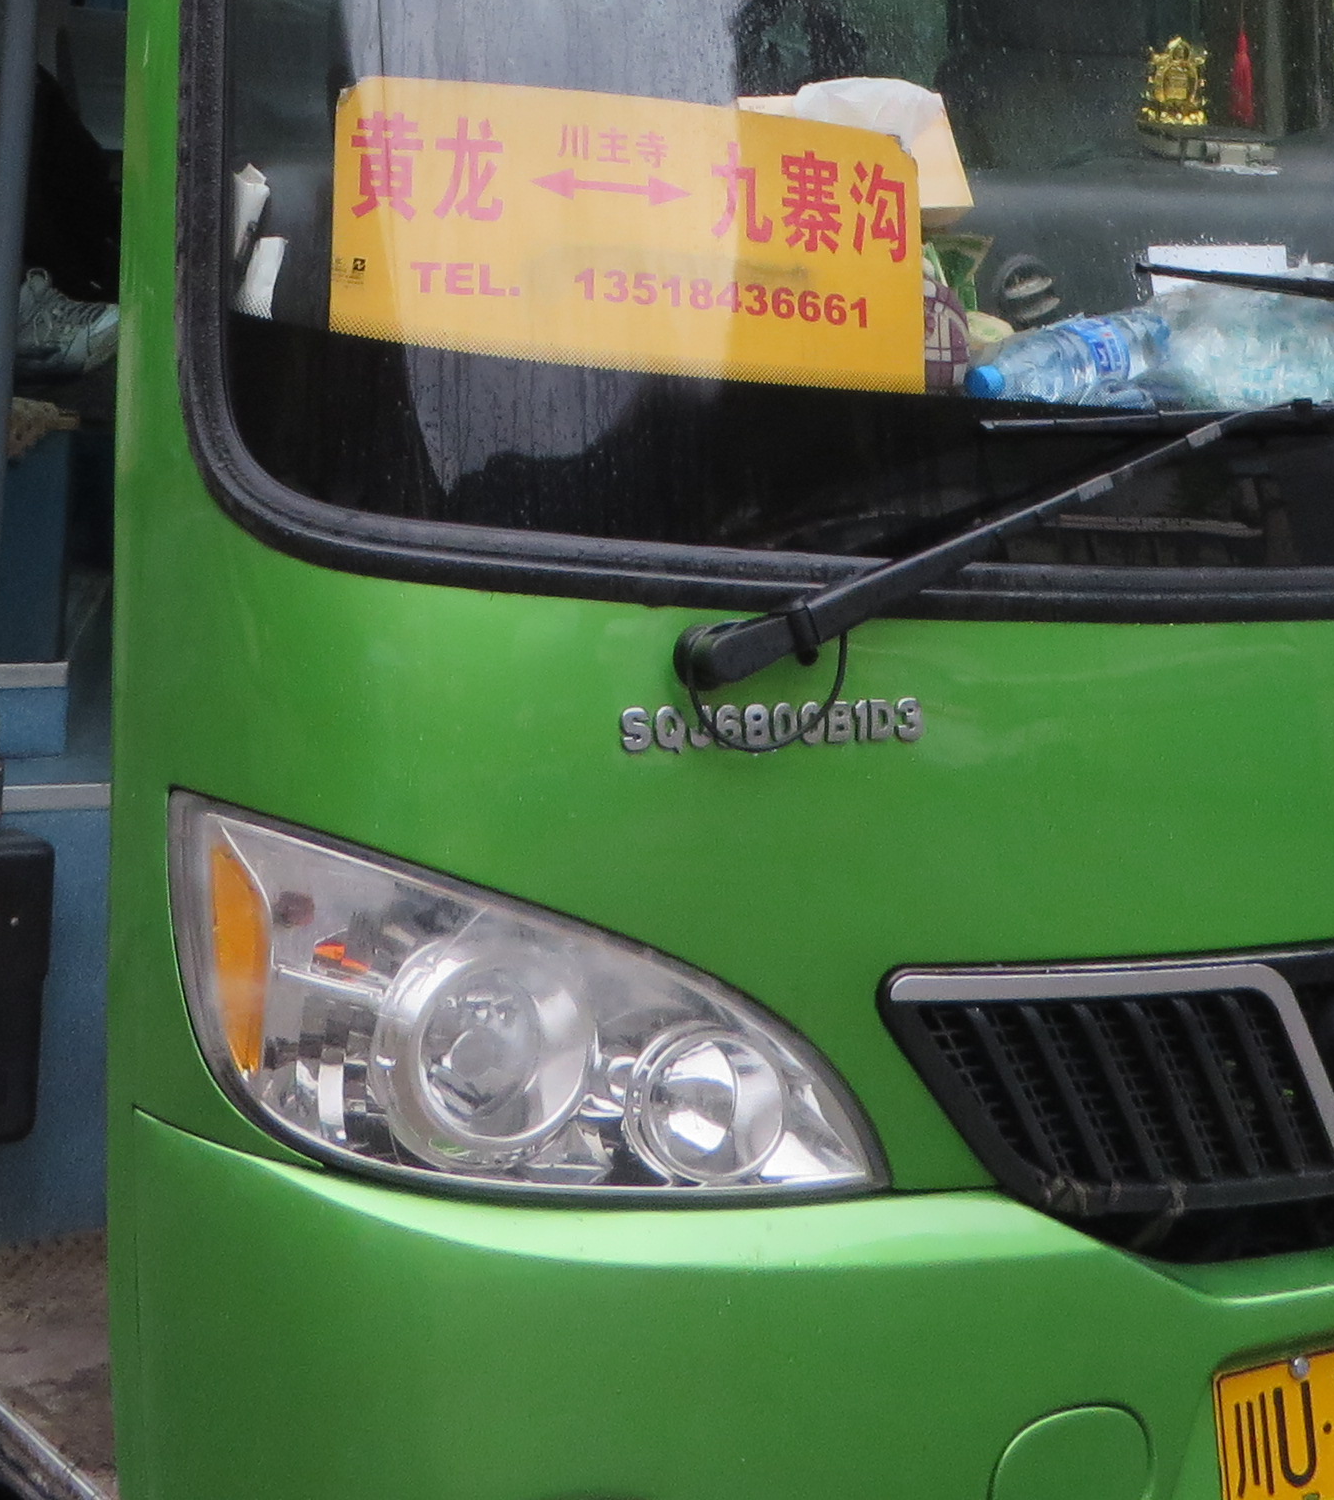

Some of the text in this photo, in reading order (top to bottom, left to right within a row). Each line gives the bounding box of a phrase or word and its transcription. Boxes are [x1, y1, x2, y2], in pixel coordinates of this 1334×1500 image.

[557, 123, 670, 167] 川主寺
[350, 110, 908, 264] 黄龙 九寨沟
[410, 261, 521, 299] TEL.
[574, 267, 870, 330] 13518436661
